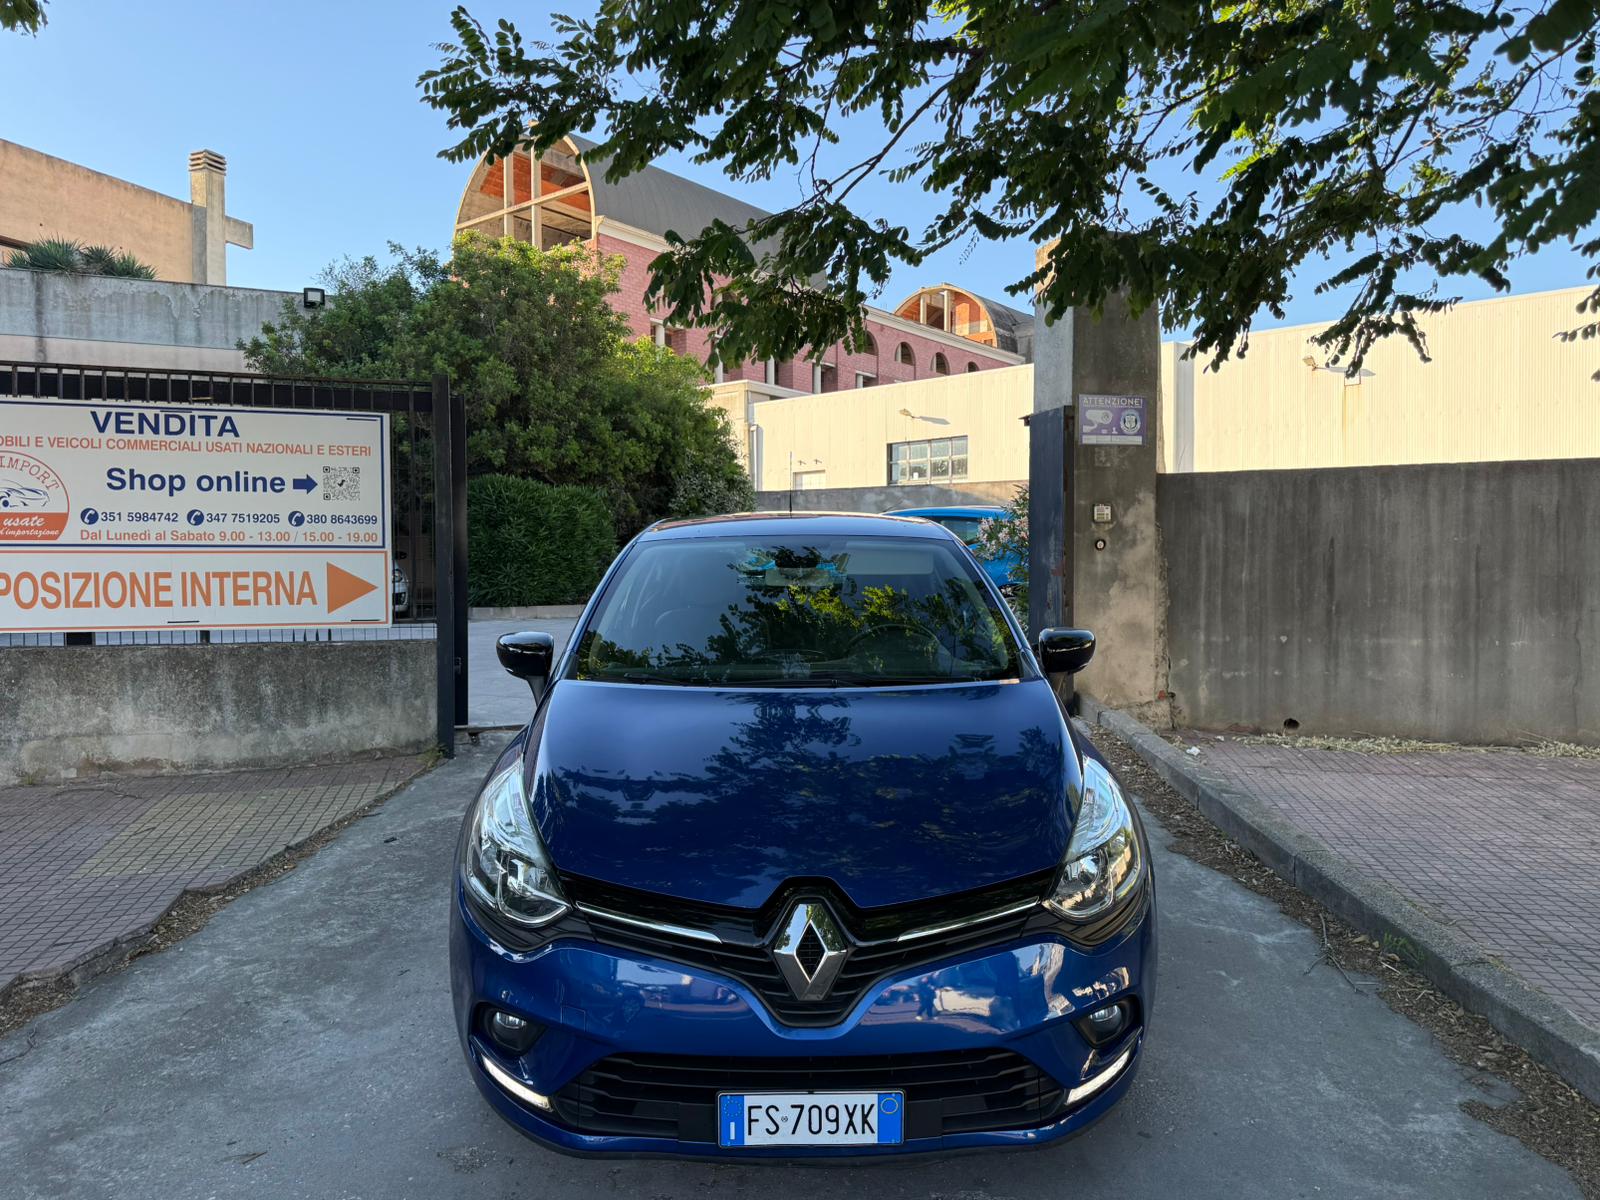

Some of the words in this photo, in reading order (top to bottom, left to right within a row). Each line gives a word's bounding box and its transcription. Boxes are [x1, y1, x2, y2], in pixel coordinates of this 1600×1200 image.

[90, 411, 240, 437] VENDITA
[35, 436, 44, 448] E
[48, 437, 102, 449] VEICOLI
[106, 439, 203, 452] COMMERCIALI
[206, 442, 242, 454] USATI
[247, 443, 313, 455] NAZIONALI
[317, 445, 325, 455] E
[329, 445, 371, 457] ESTERI
[106, 467, 186, 497] Shop
[196, 471, 286, 493] online
[3, 515, 45, 527] usate
[101, 511, 122, 522] 351
[127, 512, 179, 523] 5984742
[206, 512, 227, 523] 347
[232, 513, 280, 524] 7519205
[306, 514, 327, 525] 380
[330, 514, 378, 525] 8643699
[80, 529, 102, 541] Dal
[106, 529, 151, 541] Lunedì
[155, 530, 166, 541] al
[170, 530, 215, 542] Sabato
[219, 530, 246, 542] 9.00
[257, 531, 290, 543] 13.00
[303, 532, 335, 543] 15.00
[347, 532, 378, 543] 19.00
[181, 570, 318, 608] INTERNA
[730, 1121, 736, 1140] I
